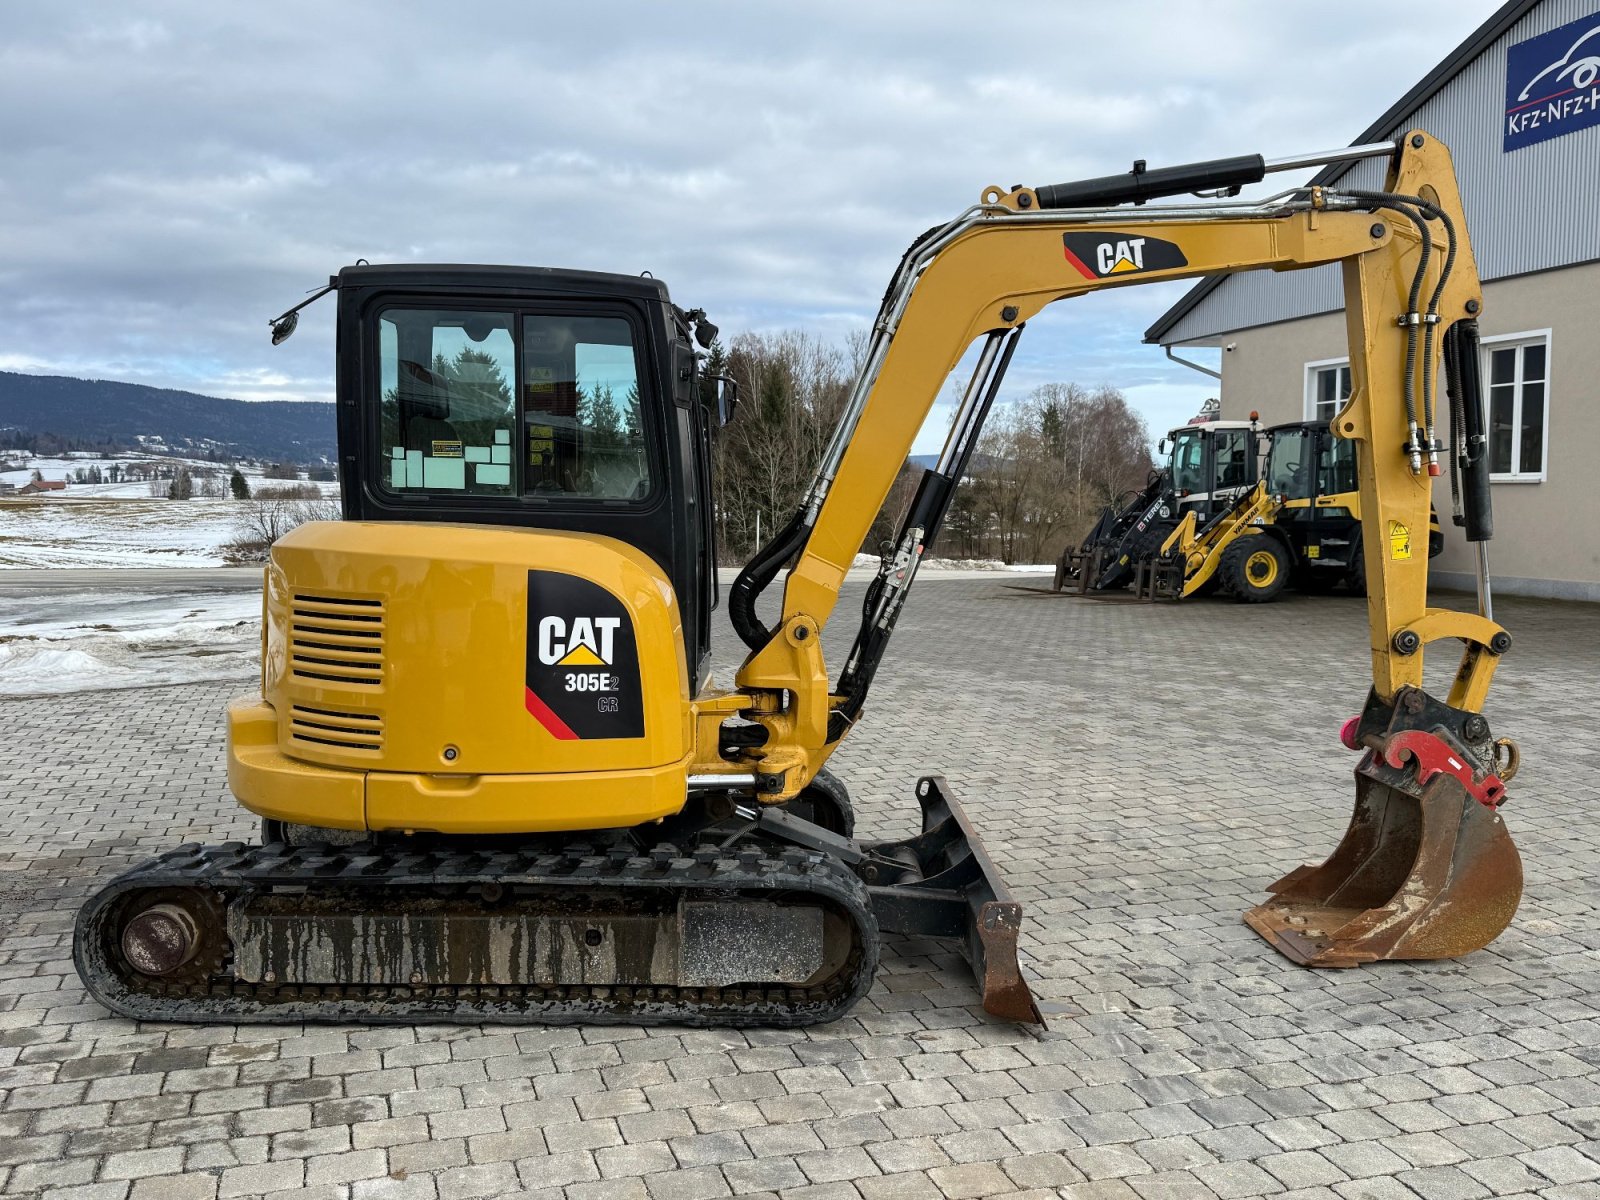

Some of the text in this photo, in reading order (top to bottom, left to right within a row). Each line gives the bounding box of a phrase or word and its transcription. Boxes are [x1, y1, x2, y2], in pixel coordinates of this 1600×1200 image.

[1096, 238, 1145, 274] CAT
[1143, 497, 1165, 522] TEREX
[1161, 507, 1169, 516] 20
[1233, 506, 1260, 535] YANMAR
[538, 615, 621, 666] CAT
[564, 672, 620, 692] 305E2
[597, 696, 619, 713] CR
